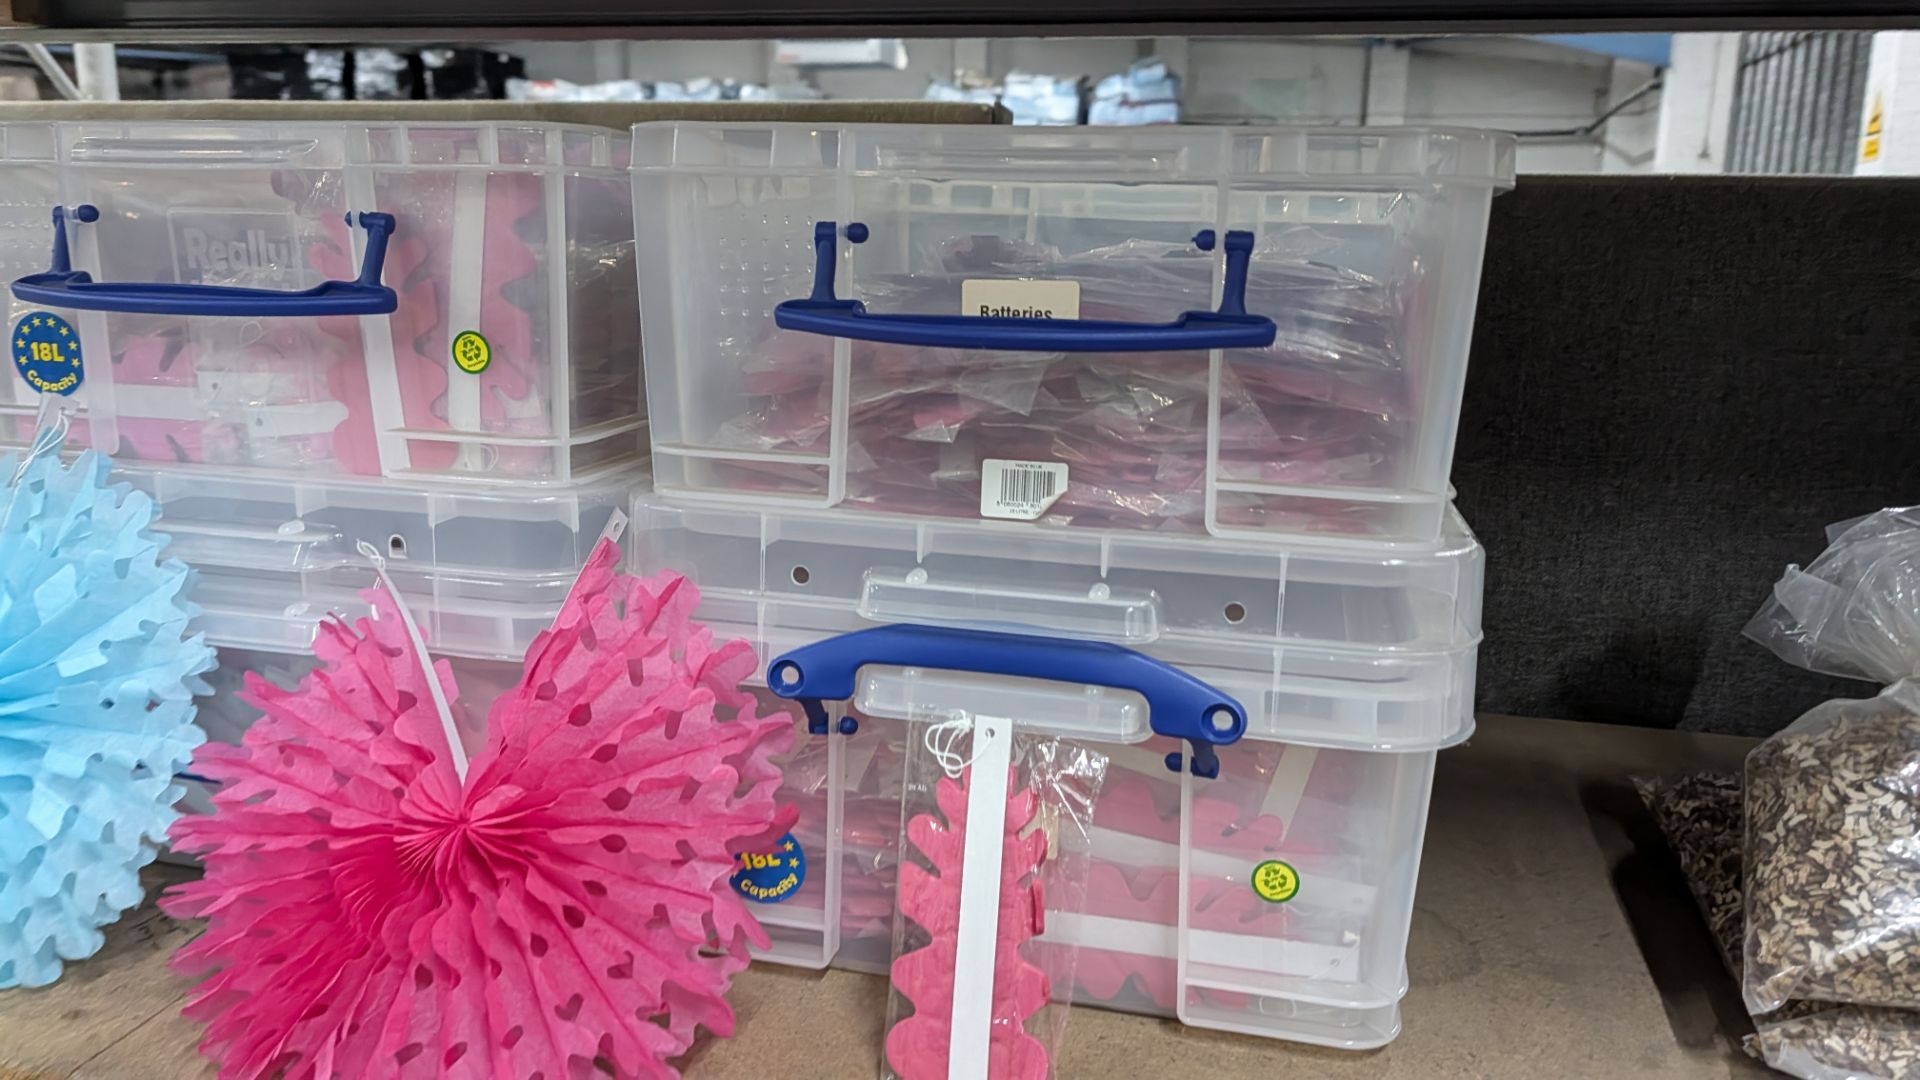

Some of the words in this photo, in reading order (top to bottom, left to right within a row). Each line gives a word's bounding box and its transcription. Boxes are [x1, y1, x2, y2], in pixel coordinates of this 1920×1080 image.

[184, 227, 288, 281] Really
[980, 305, 1053, 319] Batteries
[30, 341, 65, 362] 18L
[27, 369, 77, 391] Capacity
[741, 873, 797, 899] Capacity
